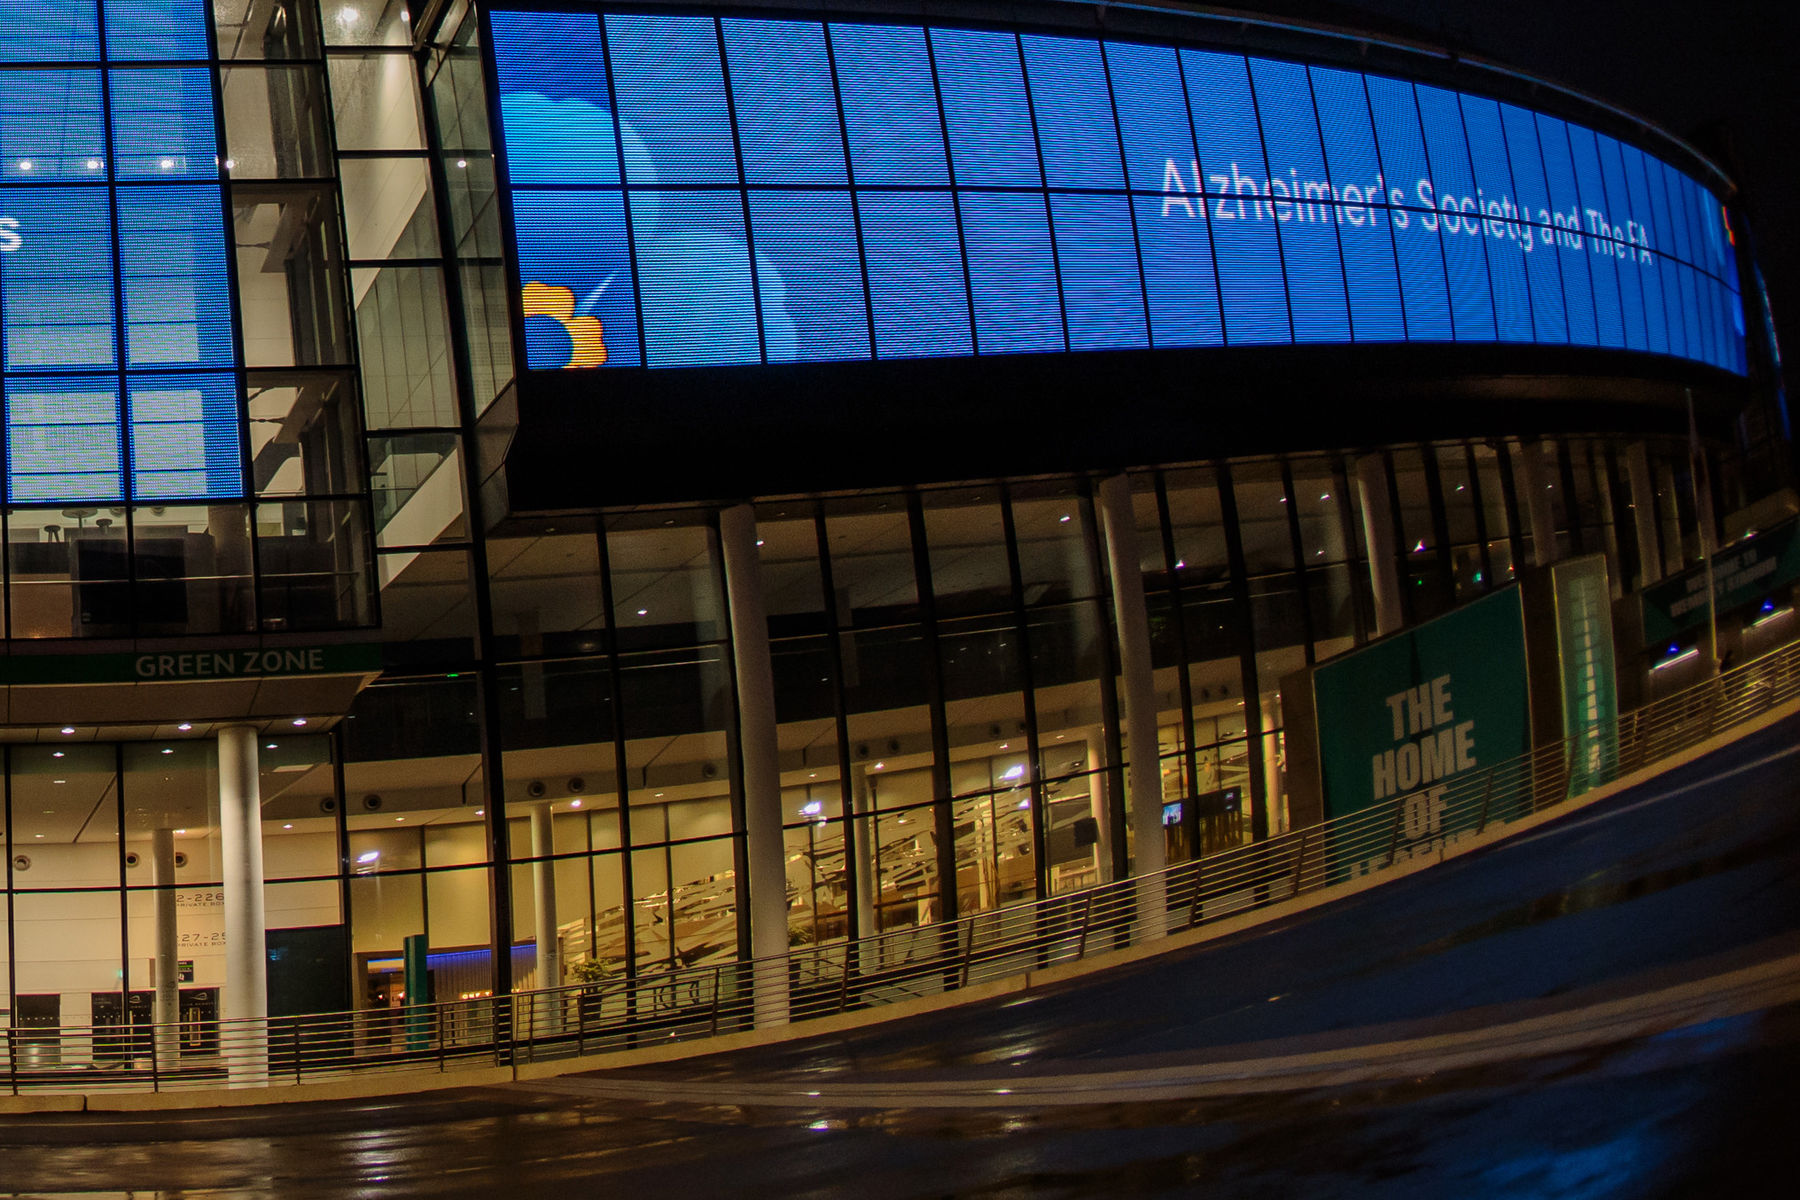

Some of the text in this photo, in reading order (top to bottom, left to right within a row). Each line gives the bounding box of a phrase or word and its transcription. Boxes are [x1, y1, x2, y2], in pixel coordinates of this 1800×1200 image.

[1161, 159, 1409, 228] Alzheimer's
[1416, 179, 1533, 252] Society
[1539, 206, 1584, 250] and
[135, 649, 325, 677] GREEN ZONE
[1385, 673, 1454, 741] THE
[1372, 720, 1477, 801] HOME
[1403, 785, 1449, 840] OF
